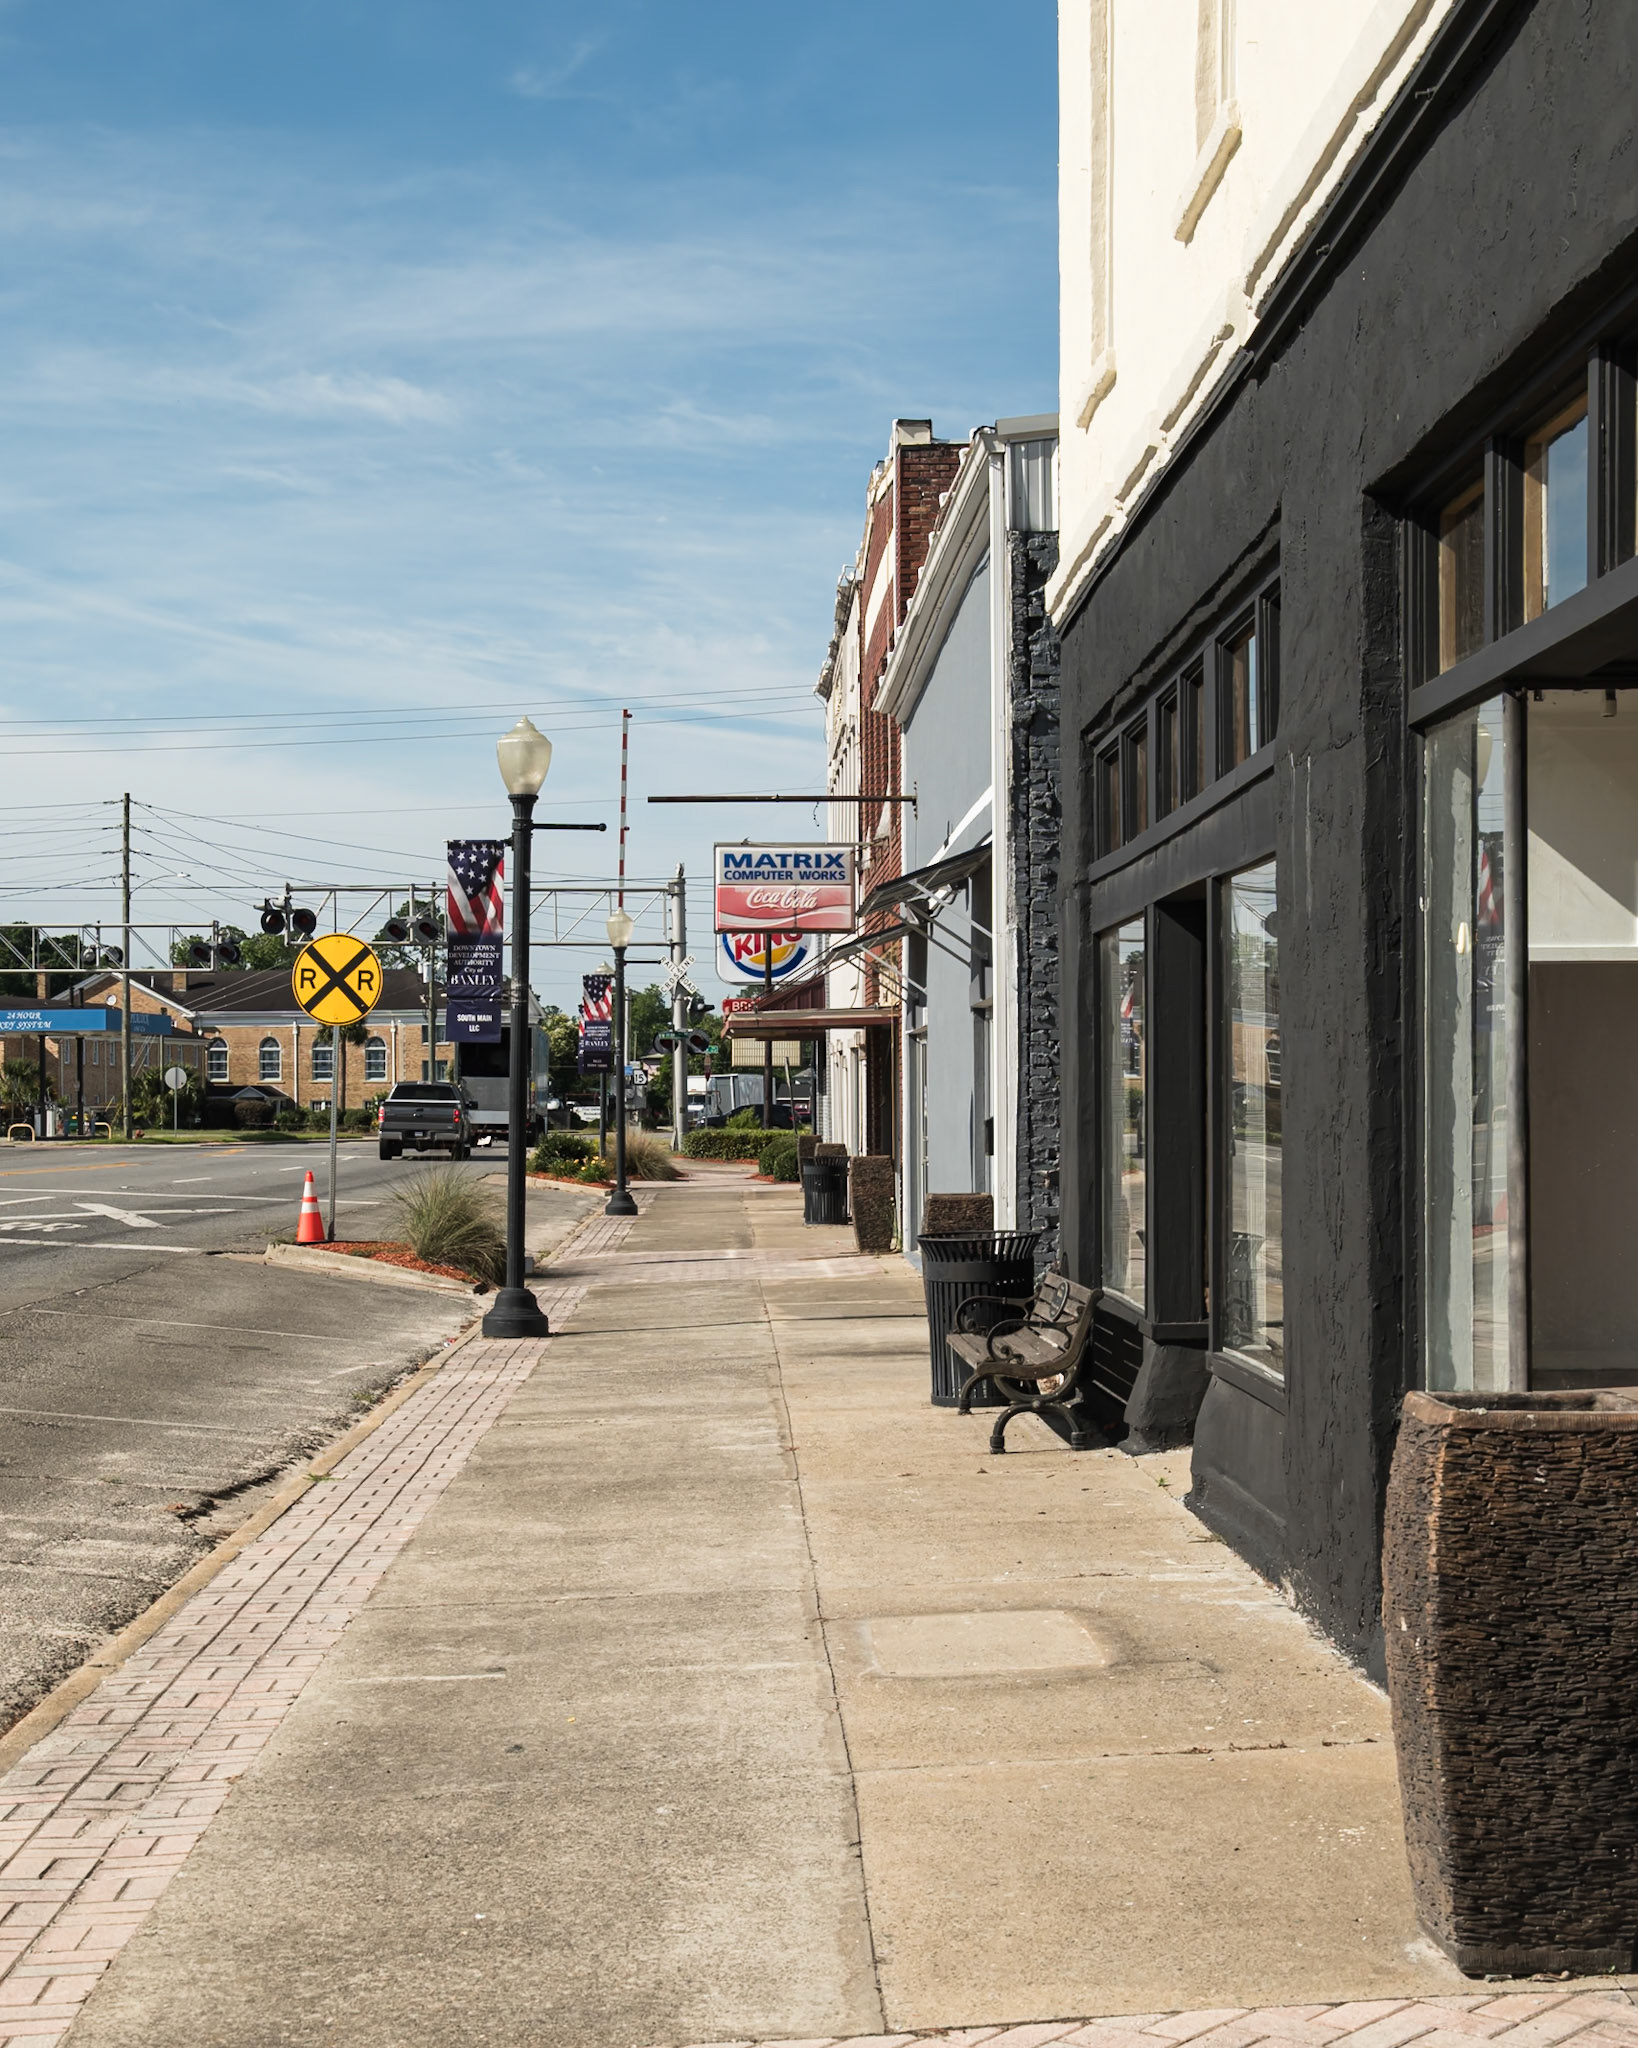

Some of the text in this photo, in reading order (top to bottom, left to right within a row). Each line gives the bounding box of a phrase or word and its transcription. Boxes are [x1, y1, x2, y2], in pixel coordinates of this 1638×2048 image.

[723, 853, 846, 869] MATRIX
[724, 870, 846, 881] COMPUTER WORKS
[746, 886, 820, 909] Coca-Cola
[300, 968, 375, 991] R R
[450, 974, 497, 986] BAXLEY
[7, 1011, 42, 1020] 24 HOUR
[456, 1014, 493, 1022] SOUTH MAIN
[16, 1020, 52, 1030] SYSTEM
[468, 1024, 480, 1032] LLC
[635, 1073, 644, 1083] 15
